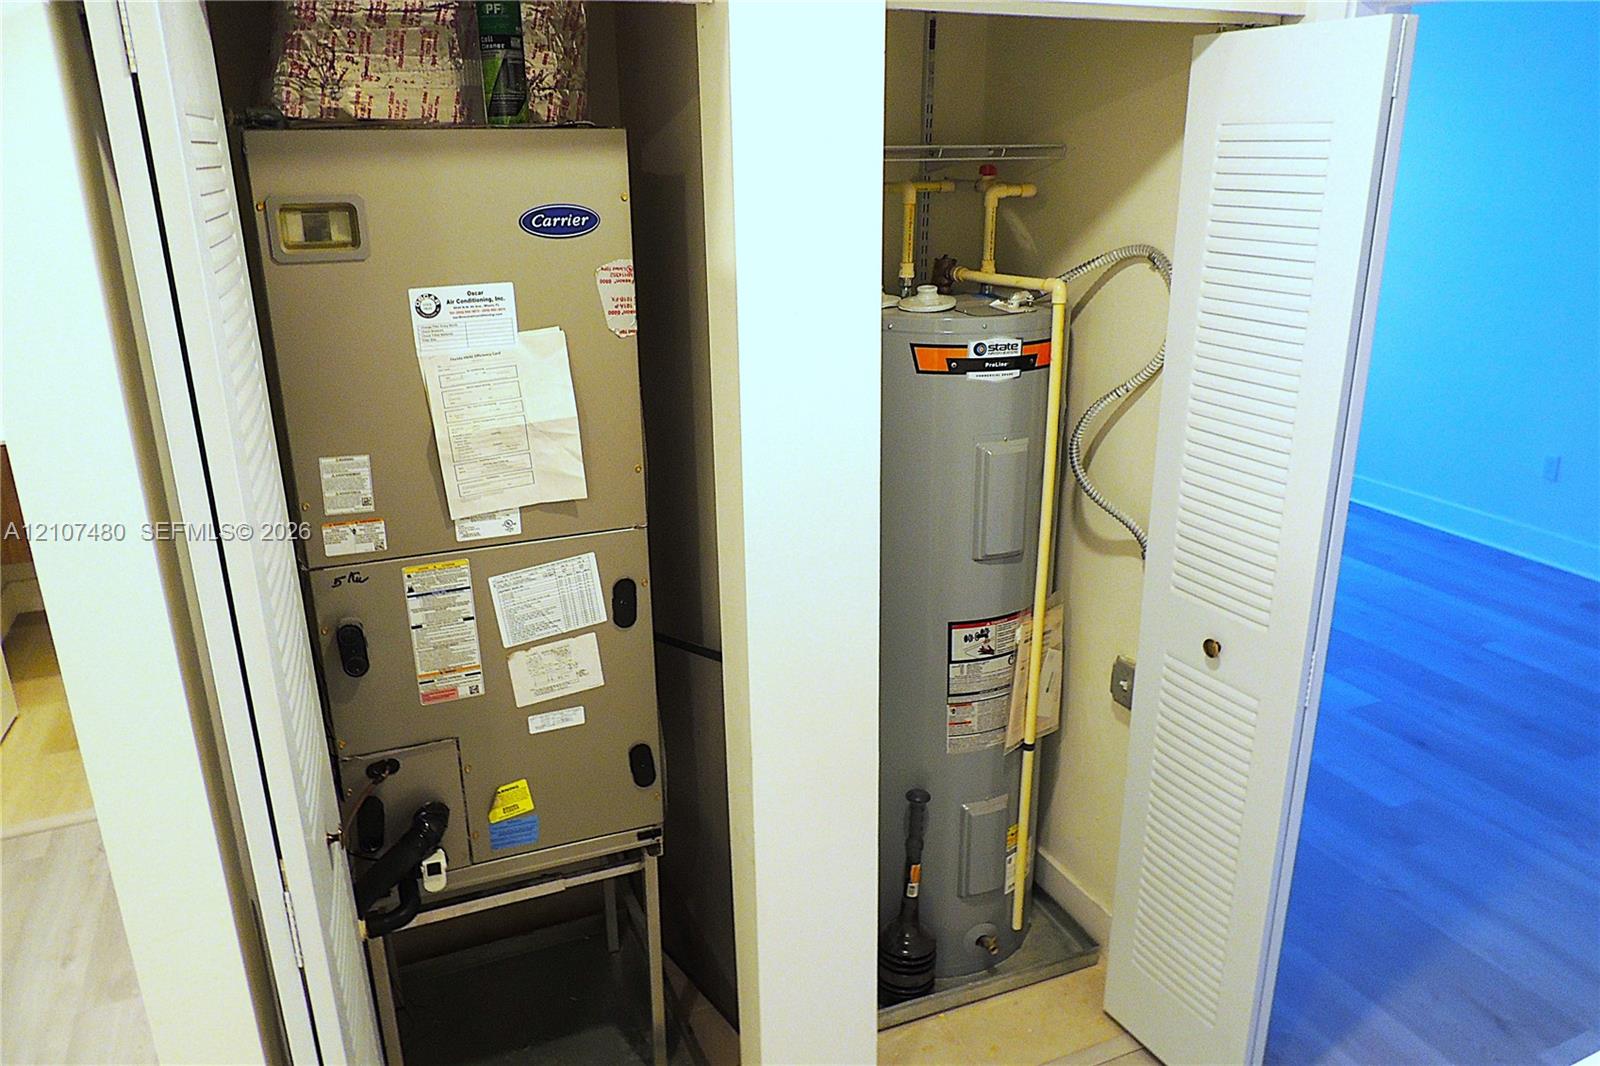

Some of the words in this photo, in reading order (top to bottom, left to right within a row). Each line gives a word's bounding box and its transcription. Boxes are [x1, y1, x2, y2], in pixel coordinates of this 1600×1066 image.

[531, 213, 589, 229] Carrier
[456, 296, 494, 304] Conditioning,
[988, 342, 1019, 352] state
